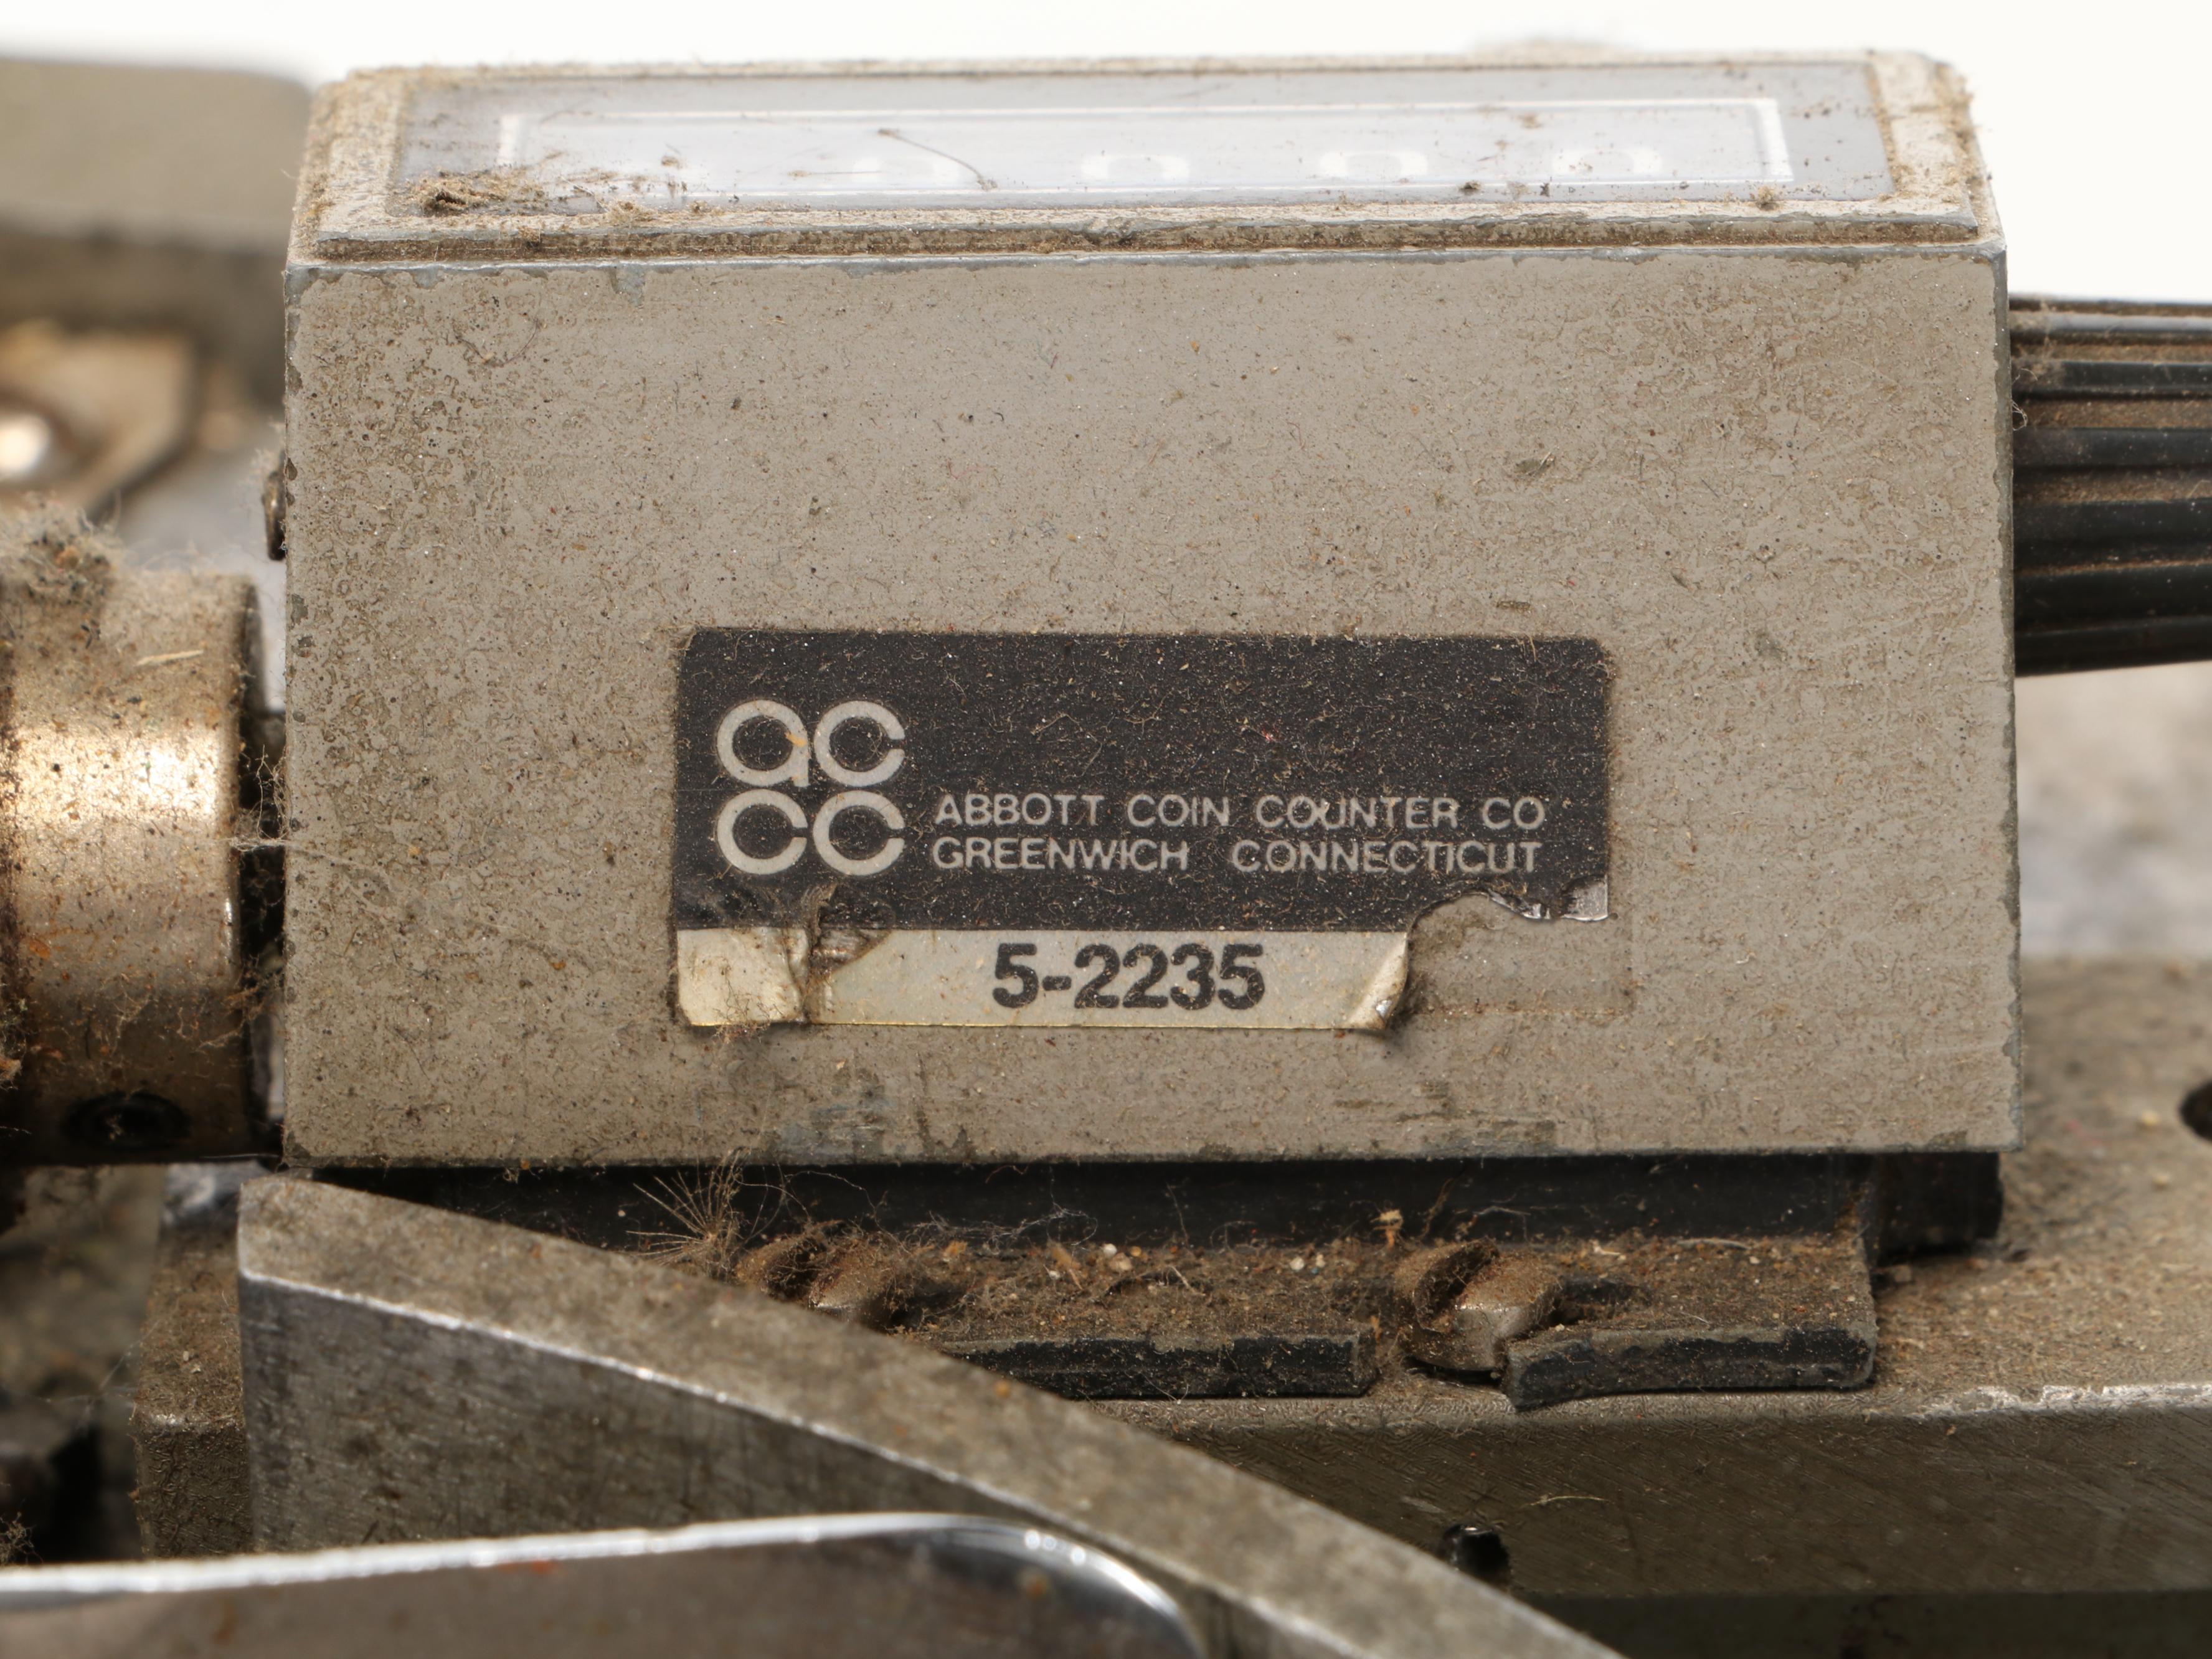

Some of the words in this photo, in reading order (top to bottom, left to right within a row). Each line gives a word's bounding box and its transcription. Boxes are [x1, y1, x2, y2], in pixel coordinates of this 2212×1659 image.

[934, 792, 1105, 826] ABBOTT
[1127, 793, 1230, 827] COIN
[1255, 794, 1460, 830] COUNTER
[1482, 796, 1546, 830] CO
[933, 836, 1188, 871] GREENWICH
[1231, 838, 1543, 874] CONNECTICUT
[992, 942, 1265, 1010] 5-2235
